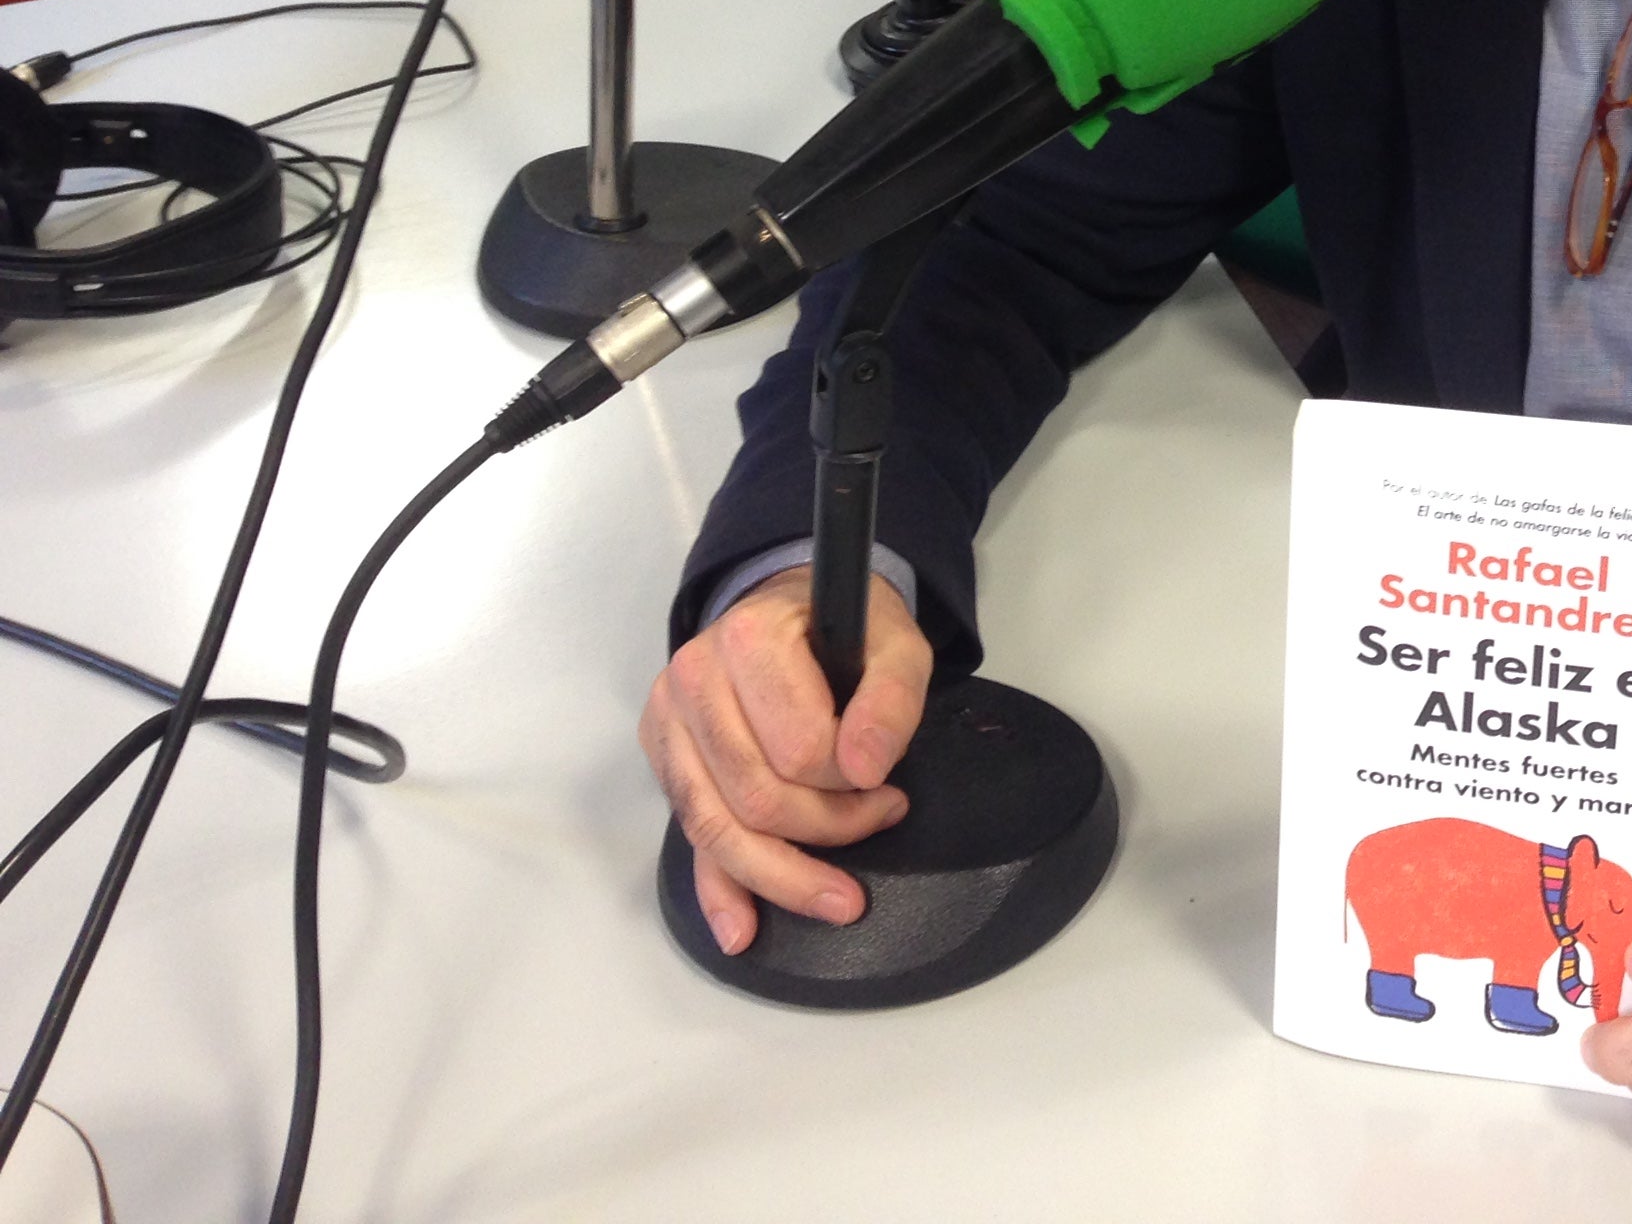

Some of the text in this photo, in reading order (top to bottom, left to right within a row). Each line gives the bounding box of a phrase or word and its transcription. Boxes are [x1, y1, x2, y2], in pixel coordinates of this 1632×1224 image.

[1417, 505, 1431, 517] El
[1433, 510, 1463, 522] arte
[1466, 511, 1486, 525] de
[1490, 517, 1509, 528] no
[1512, 519, 1593, 537] amargarse
[1597, 526, 1611, 540] la
[1470, 491, 1488, 504] de
[1494, 494, 1517, 508] Las
[1521, 498, 1562, 514] gafas
[1566, 502, 1586, 516] de
[1589, 504, 1604, 518] la
[1448, 541, 1610, 592] Rafael
[1356, 625, 1451, 674] Ser
[1472, 639, 1594, 693] feliz
[1414, 691, 1618, 750] Alaska
[1410, 743, 1618, 785] Mentes fuertes
[1356, 769, 1442, 794] contra
[1454, 779, 1540, 805] viento
[1551, 794, 1568, 813] y
